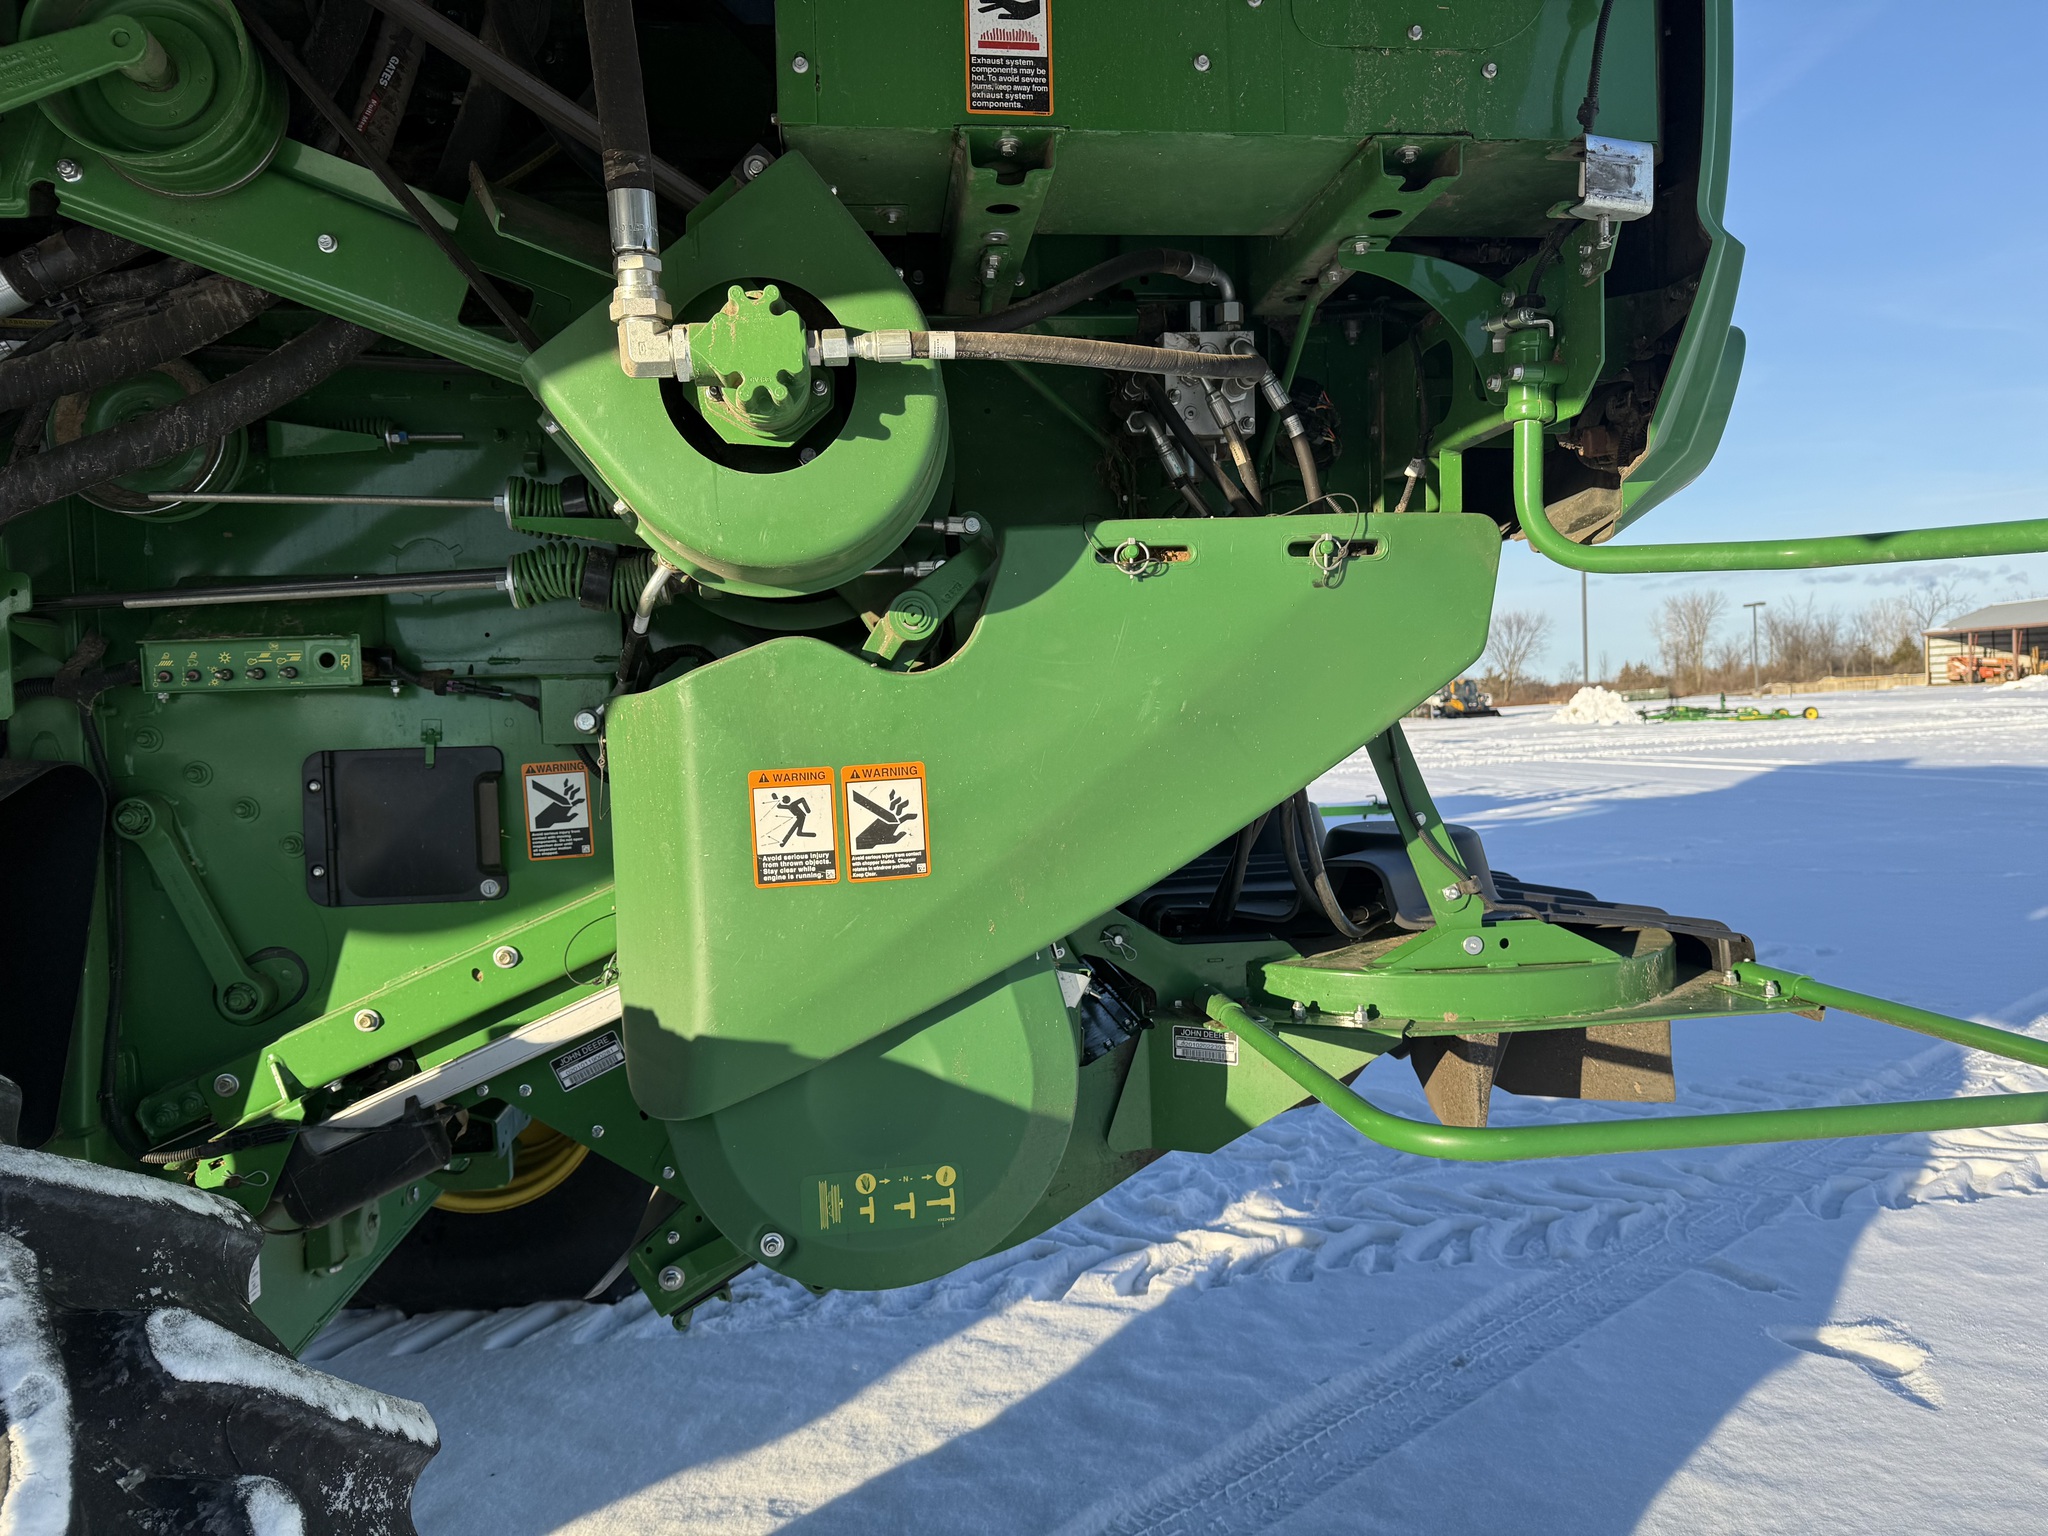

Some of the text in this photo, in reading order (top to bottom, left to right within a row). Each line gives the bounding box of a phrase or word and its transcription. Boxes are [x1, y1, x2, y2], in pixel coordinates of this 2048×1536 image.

[379, 56, 400, 87] GATES
[995, 83, 1012, 92] keep
[536, 762, 584, 773] WARNING
[863, 766, 918, 778] WARNING
[773, 772, 826, 782] WARNING
[1181, 1029, 1201, 1037] JOHN
[1204, 1031, 1229, 1040] DEERE
[560, 1050, 581, 1066] JOHN
[582, 1036, 609, 1054] DEERE
